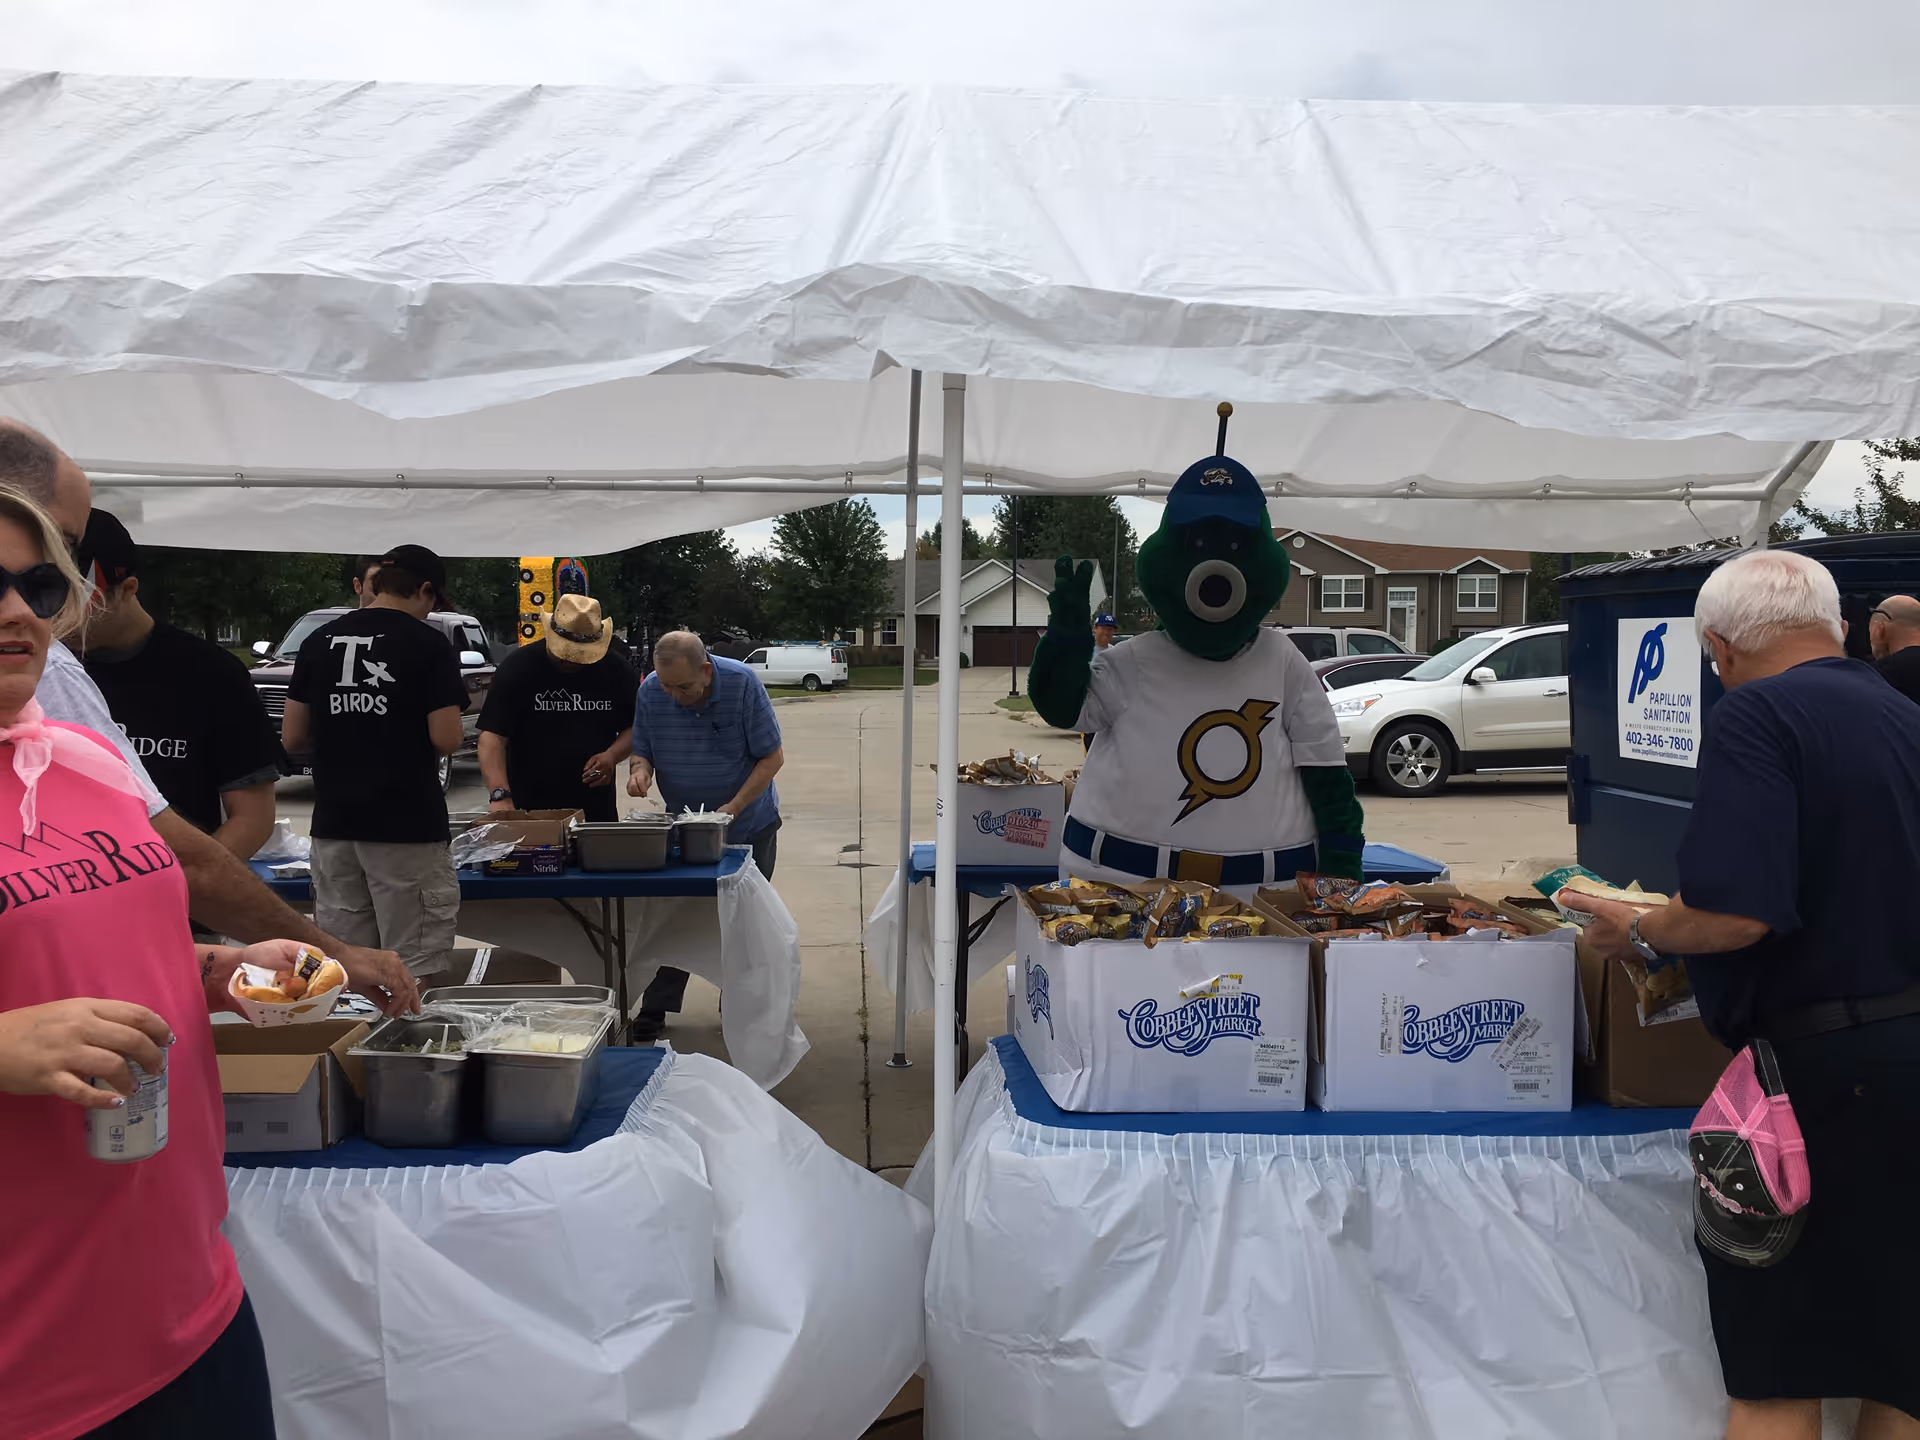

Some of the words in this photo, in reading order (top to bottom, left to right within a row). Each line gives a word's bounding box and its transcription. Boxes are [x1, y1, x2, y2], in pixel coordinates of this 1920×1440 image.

[329, 692, 388, 716] BIRDS
[534, 692, 572, 712] SILVER
[571, 693, 613, 711] RIDGE
[1650, 692, 1692, 707] PAPILLION
[1643, 708, 1690, 724] SANITATION
[1626, 731, 1693, 752] 402-346-7800
[81, 830, 176, 884] RID
[533, 864, 559, 873] Nitrile
[1553, 872, 1566, 880] Sea
[1567, 869, 1582, 877] Salt
[1210, 1017, 1261, 1038] MARKET
